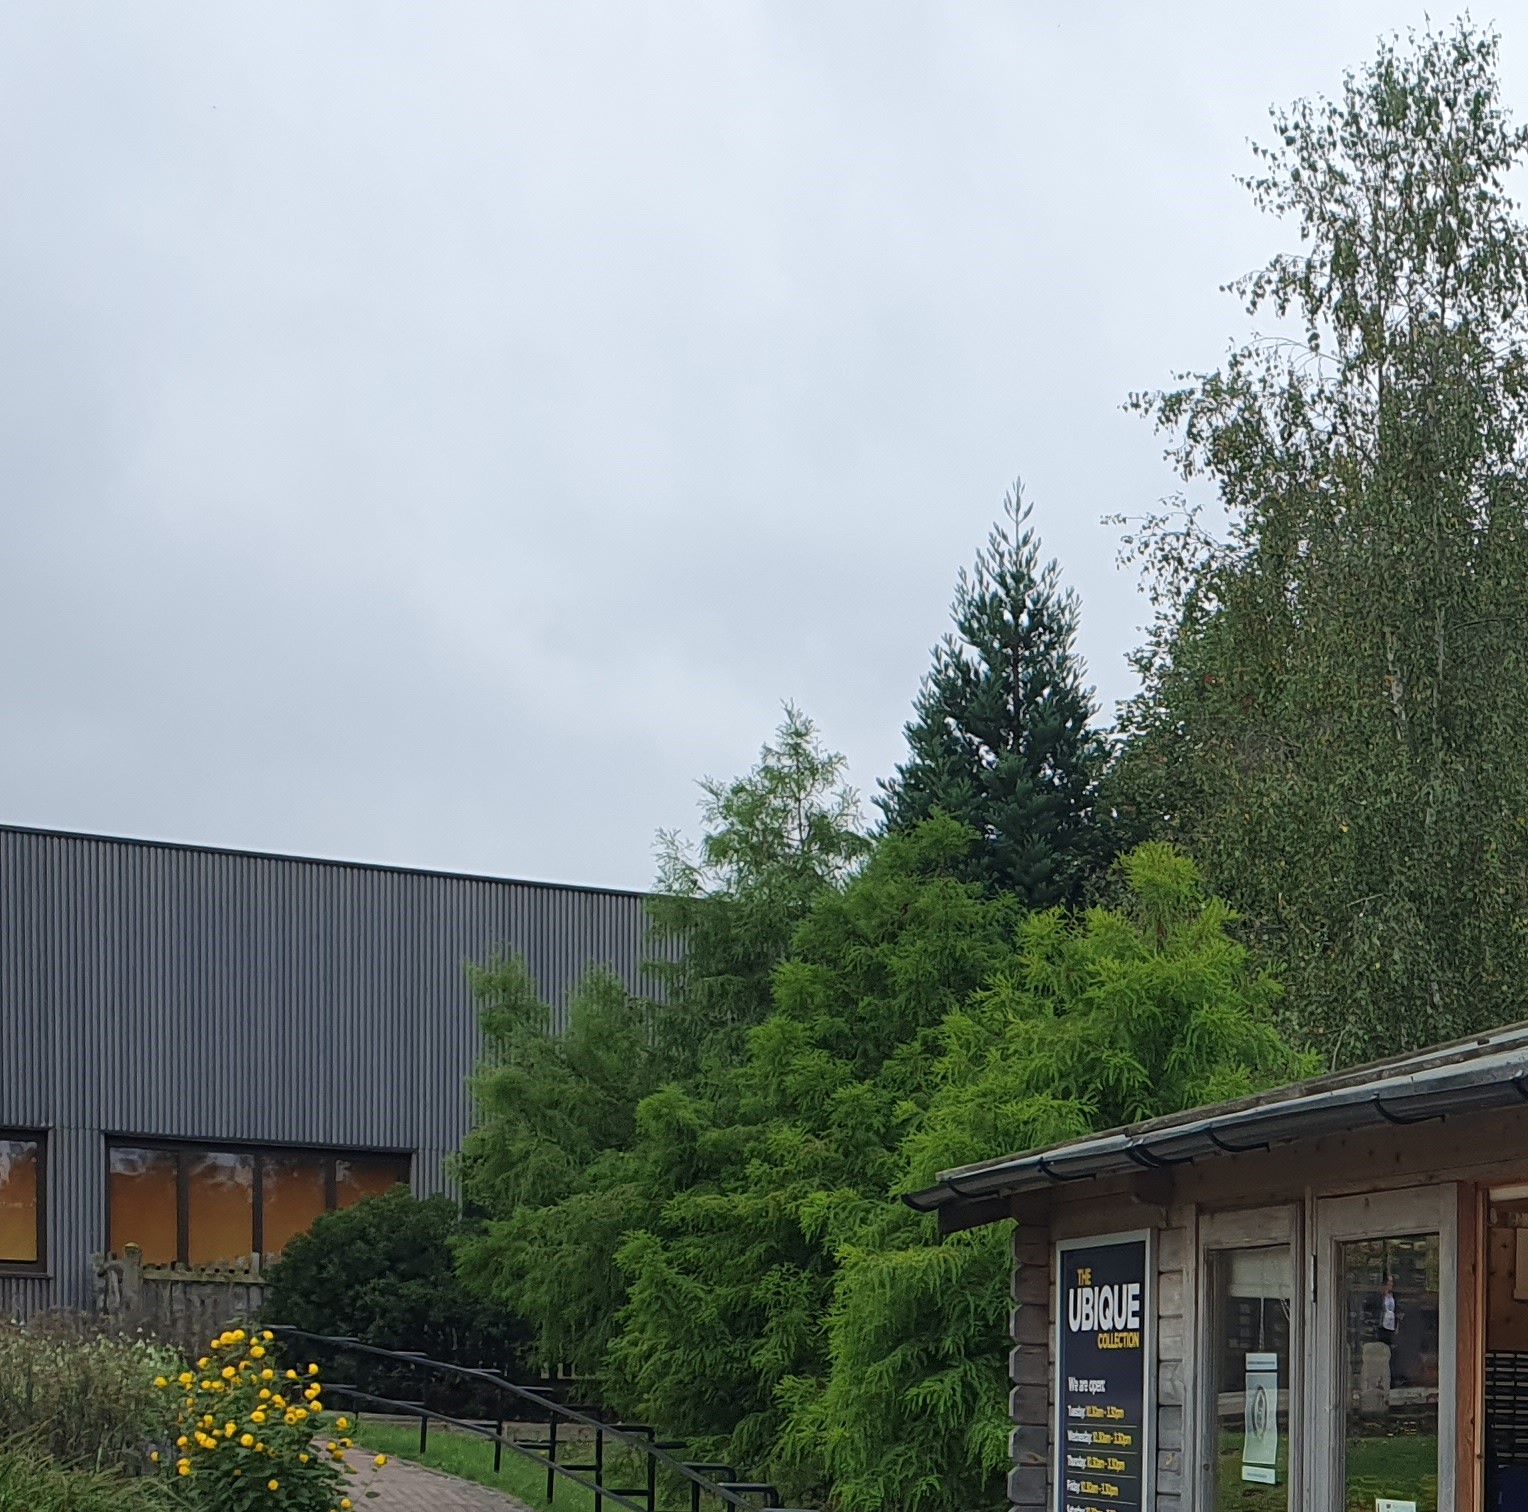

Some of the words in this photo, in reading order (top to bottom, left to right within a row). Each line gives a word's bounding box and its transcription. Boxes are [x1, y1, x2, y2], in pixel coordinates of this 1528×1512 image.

[1077, 1268, 1092, 1286] THE
[1068, 1283, 1140, 1333] UBIQUE
[1097, 1332, 1140, 1349] COLLECTION
